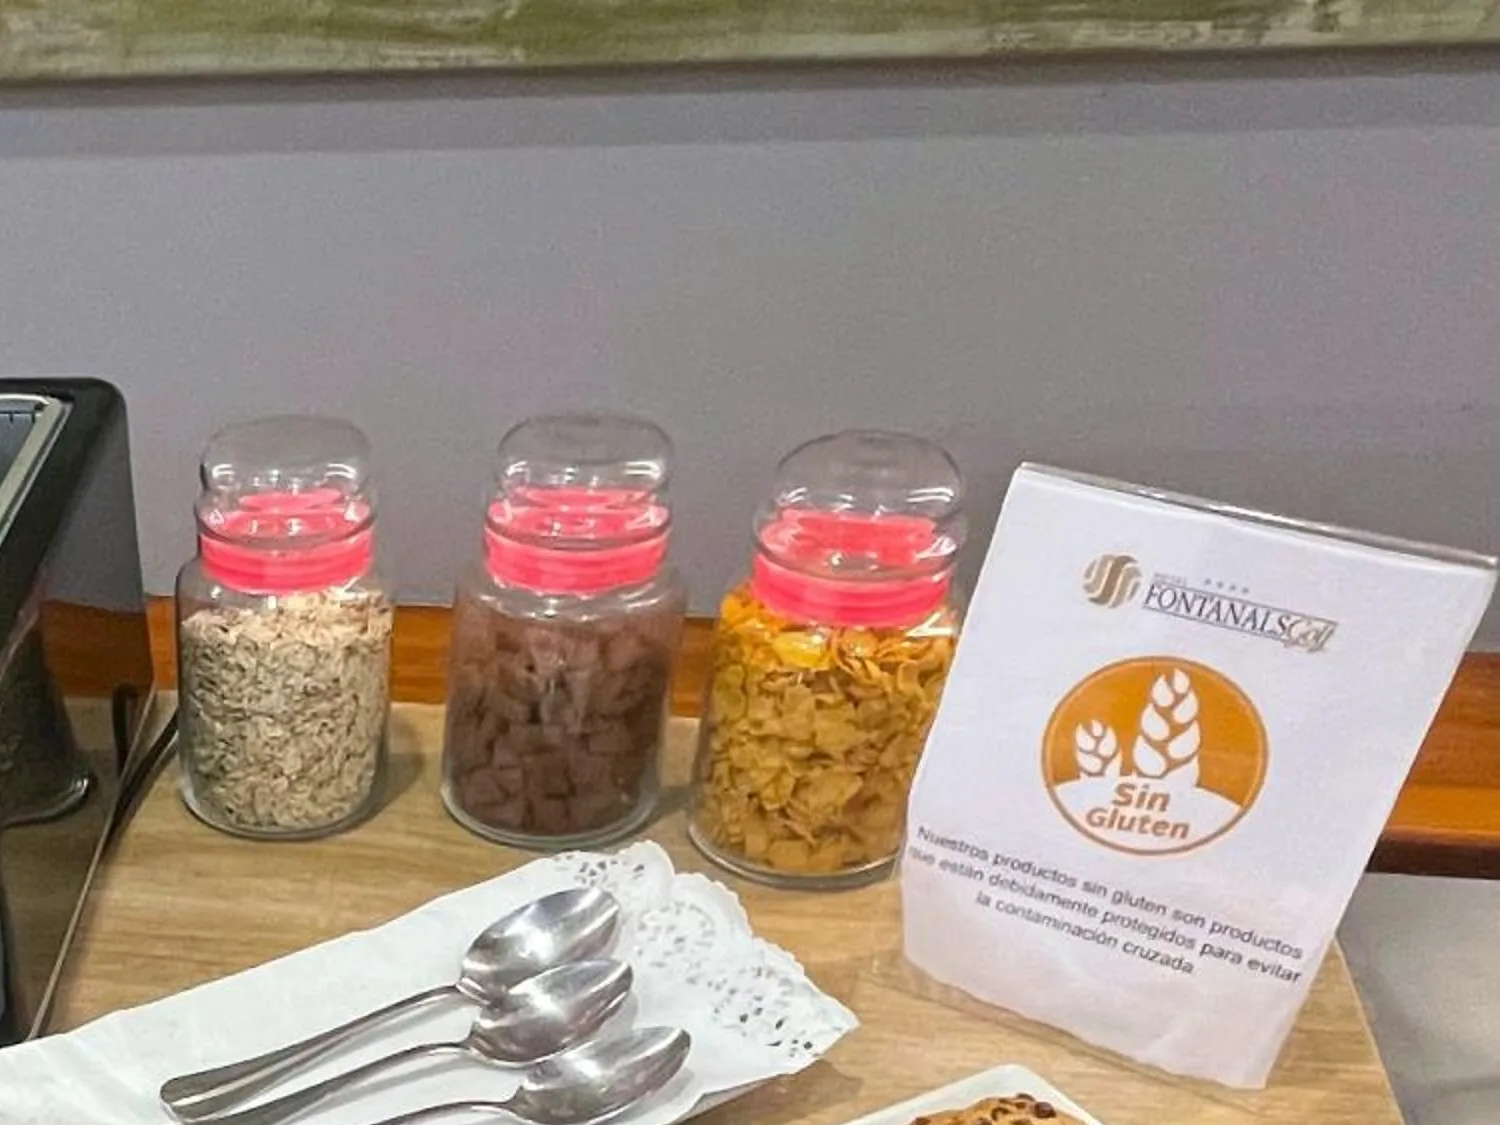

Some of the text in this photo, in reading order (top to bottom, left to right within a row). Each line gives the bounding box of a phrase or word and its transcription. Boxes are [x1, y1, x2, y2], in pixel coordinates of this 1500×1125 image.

[1143, 583, 1292, 636] FONTANALS
[1085, 807, 1190, 839] Gluten
[1112, 782, 1170, 812] Sin
[916, 826, 1303, 960] Nuestros productos sin gluten son productos
[939, 858, 984, 881] están
[989, 871, 1099, 917] debidamente
[1101, 911, 1196, 950] protegidos
[1199, 942, 1243, 965] para
[1247, 958, 1301, 983] evitar
[976, 891, 1195, 974] la contaminación cruzada
